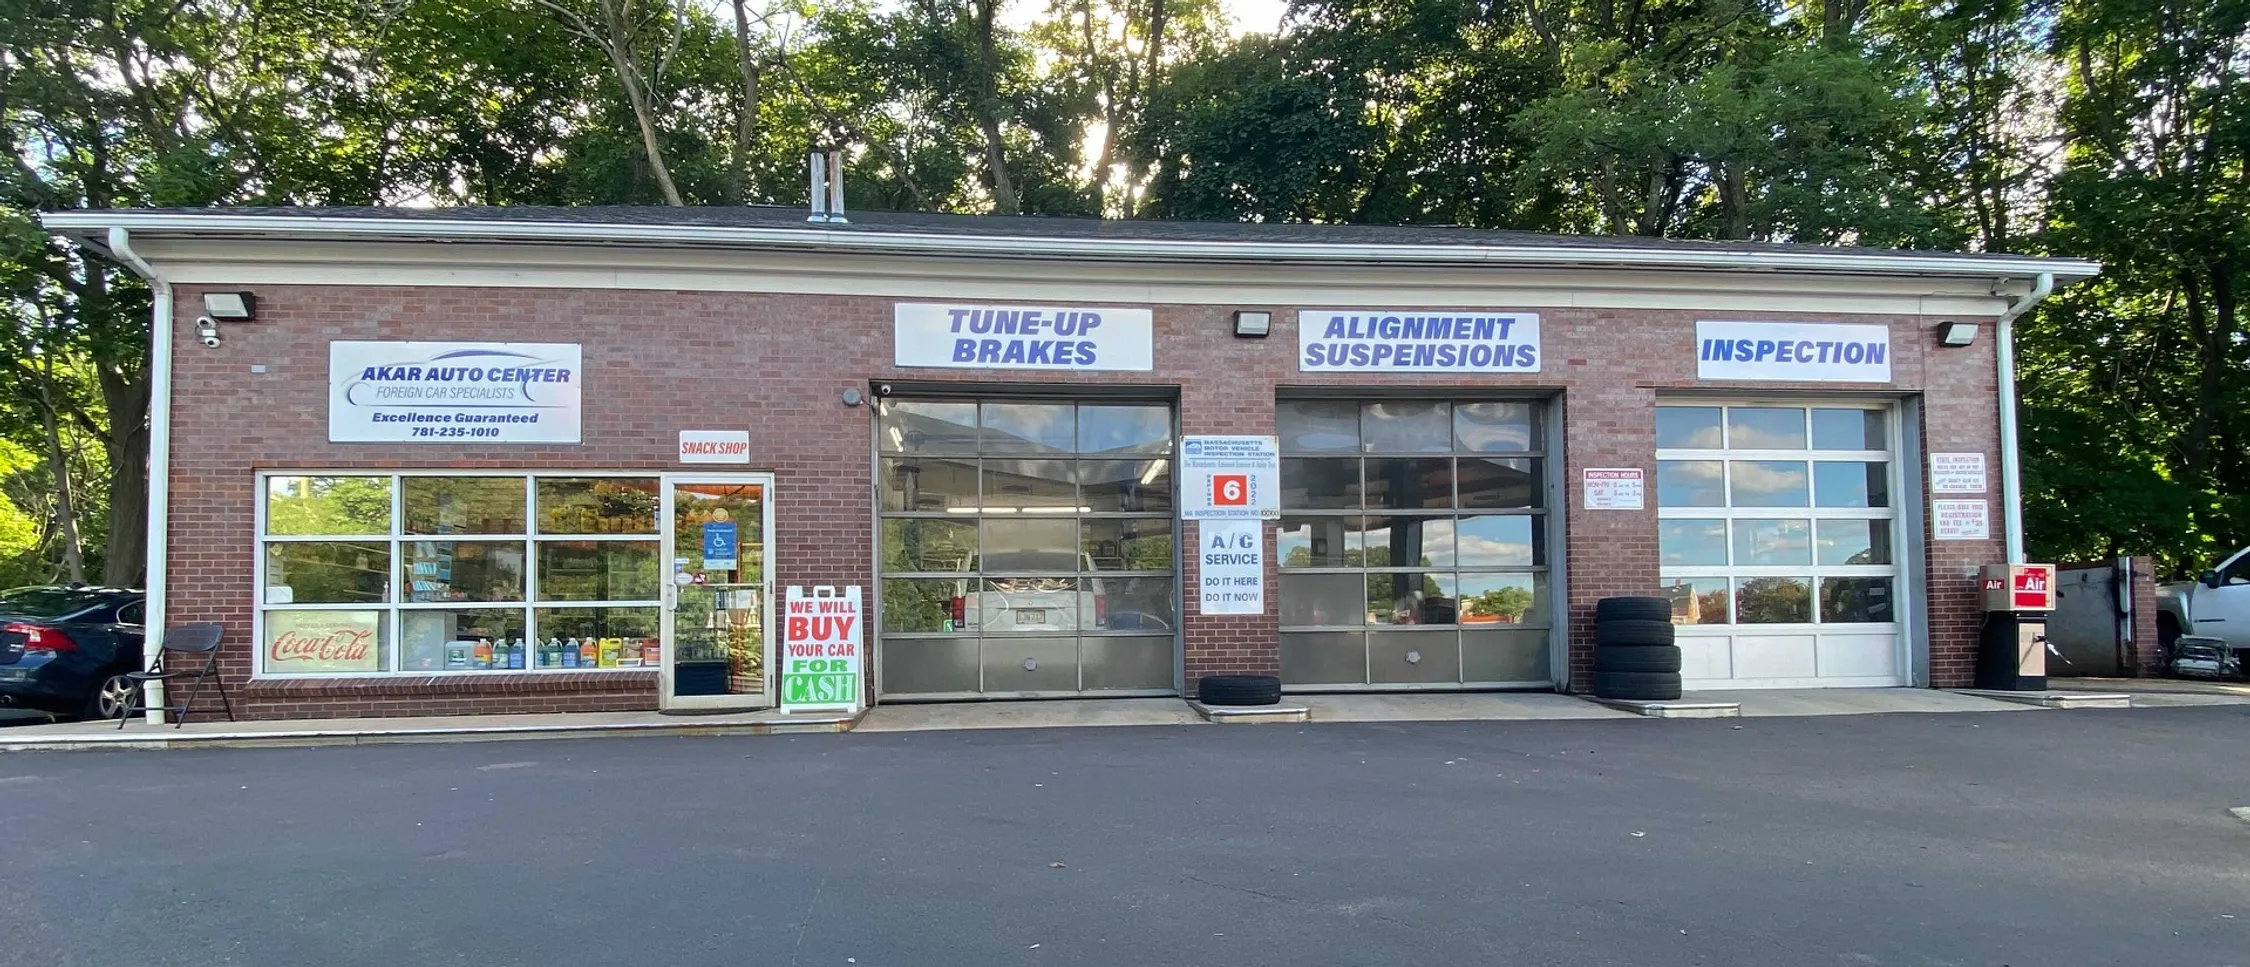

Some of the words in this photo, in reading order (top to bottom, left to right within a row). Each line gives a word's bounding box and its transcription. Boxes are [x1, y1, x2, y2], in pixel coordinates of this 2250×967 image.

[948, 309, 1102, 337] TUNE-UP
[1322, 316, 1516, 341] ALIGNMENT
[952, 338, 1097, 366] BRAKES
[1304, 342, 1536, 368] SUSPENSIONS
[1701, 338, 1886, 365] INSPECTION
[361, 366, 422, 382] AKAR
[425, 367, 484, 382] AUTO
[487, 368, 571, 383] CENTER
[376, 386, 423, 398] FOREIGN
[425, 386, 447, 398] CAR
[450, 387, 515, 399] SPECIALISTS
[372, 412, 451, 423] Excellence
[454, 413, 539, 424] Guaranteed
[411, 427, 500, 437] 781-235-1010
[682, 442, 717, 455] SNACK
[718, 442, 747, 455] SHOP
[1223, 480, 1241, 501] 6
[1211, 532, 1253, 549] A/C
[1205, 554, 1258, 565] SERVICE
[1205, 577, 1220, 586] DO
[1222, 577, 1231, 586] IT
[1234, 577, 1258, 586] HERE
[1986, 581, 2002, 590] Air
[2025, 577, 2045, 590] Air
[1205, 593, 1220, 602] DO
[1222, 593, 1231, 602] IT
[1234, 593, 1258, 602] NOW
[790, 602, 813, 613] WE
[819, 602, 856, 613] WILL
[788, 616, 855, 641] BUY
[271, 631, 373, 661] Coca-Cola
[788, 644, 823, 657] YOUR
[828, 644, 855, 657] CAR
[792, 660, 848, 673] FOR
[785, 675, 854, 702] CASH
